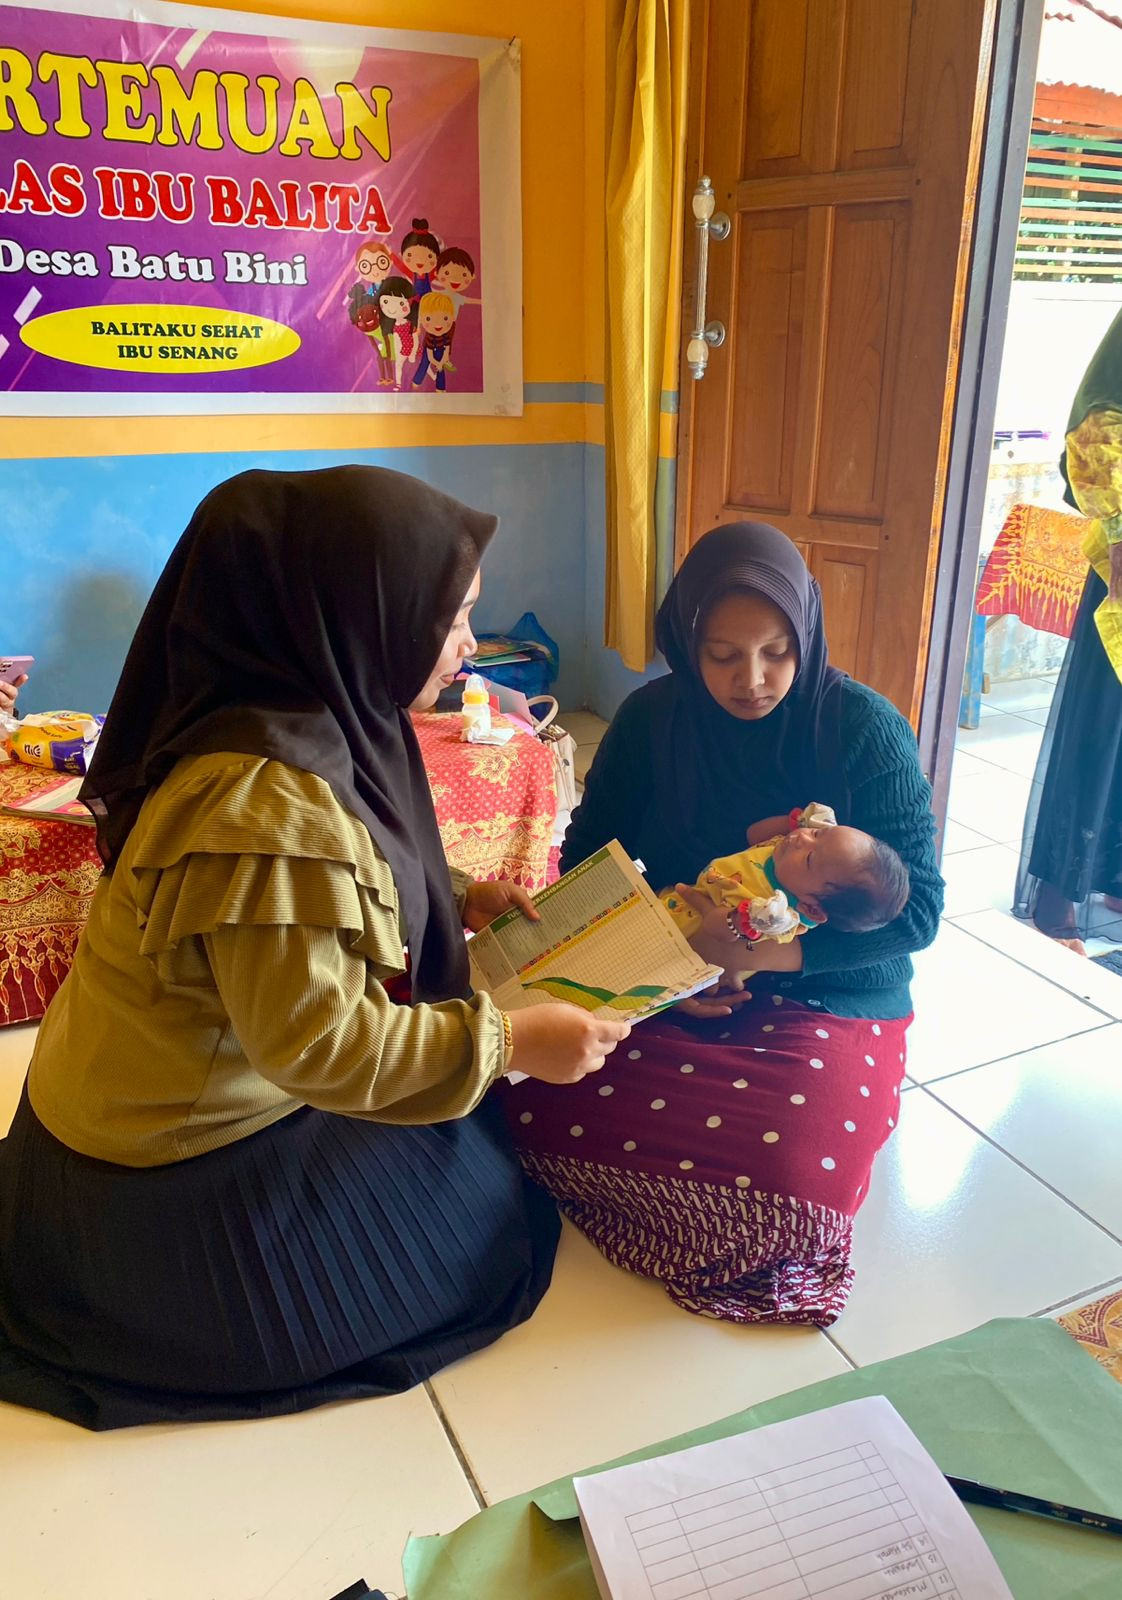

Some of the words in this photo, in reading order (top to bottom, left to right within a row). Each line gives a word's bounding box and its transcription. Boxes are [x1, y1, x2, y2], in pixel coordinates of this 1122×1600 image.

[0, 47, 392, 162] RTEMUAN
[0, 160, 86, 217] AS
[94, 167, 195, 224] IBU
[205, 177, 392, 234] BALITA
[0, 239, 99, 278] Desa
[107, 244, 215, 283] Batu
[223, 250, 309, 286] Bini
[91, 321, 196, 338] BALITAKU
[201, 324, 263, 339] SEHAT
[118, 345, 152, 359] IBU
[158, 345, 239, 360] SENANG
[577, 860, 594, 875] ANAK
